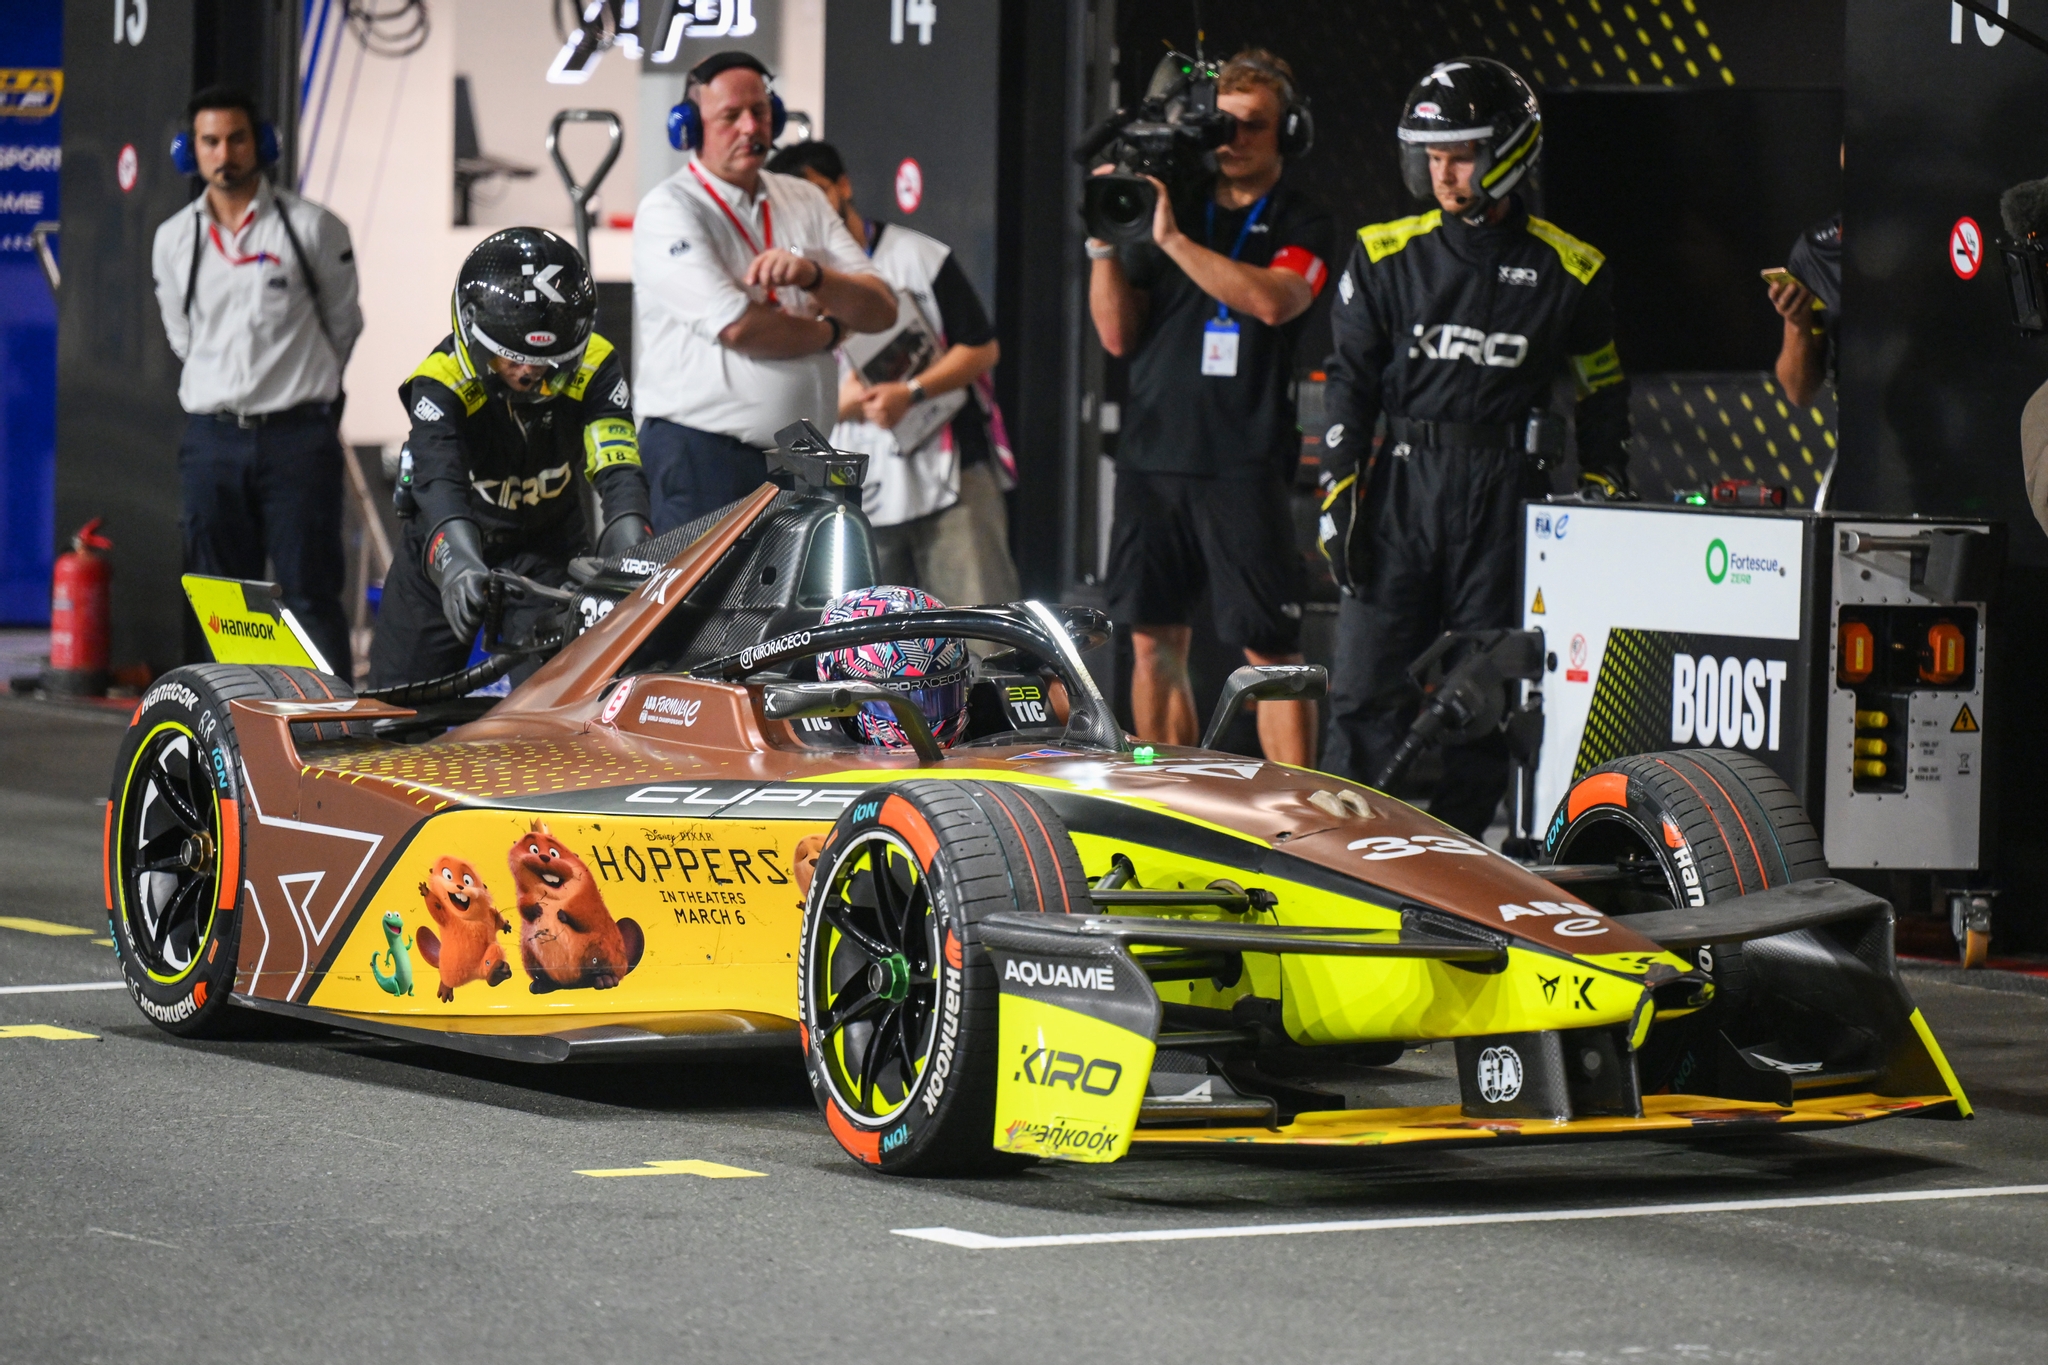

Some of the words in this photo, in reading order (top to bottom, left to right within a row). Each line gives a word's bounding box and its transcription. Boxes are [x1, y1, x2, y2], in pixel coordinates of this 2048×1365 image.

[414, 398, 442, 422] OMP
[1730, 553, 1778, 572] Fortescue
[1005, 686, 1041, 701] 33
[1672, 653, 1787, 751] BOOST
[654, 695, 690, 717] FORMULA
[1010, 700, 1048, 723] TIC
[679, 831, 715, 842] PIXAR
[1346, 836, 1488, 861] 33
[592, 845, 788, 885] HOPPERS
[662, 890, 676, 903] IN
[680, 891, 747, 905] THEATERS
[674, 908, 732, 926] MARCH
[736, 909, 746, 926] 6
[1013, 1044, 1123, 1097] KIRO
